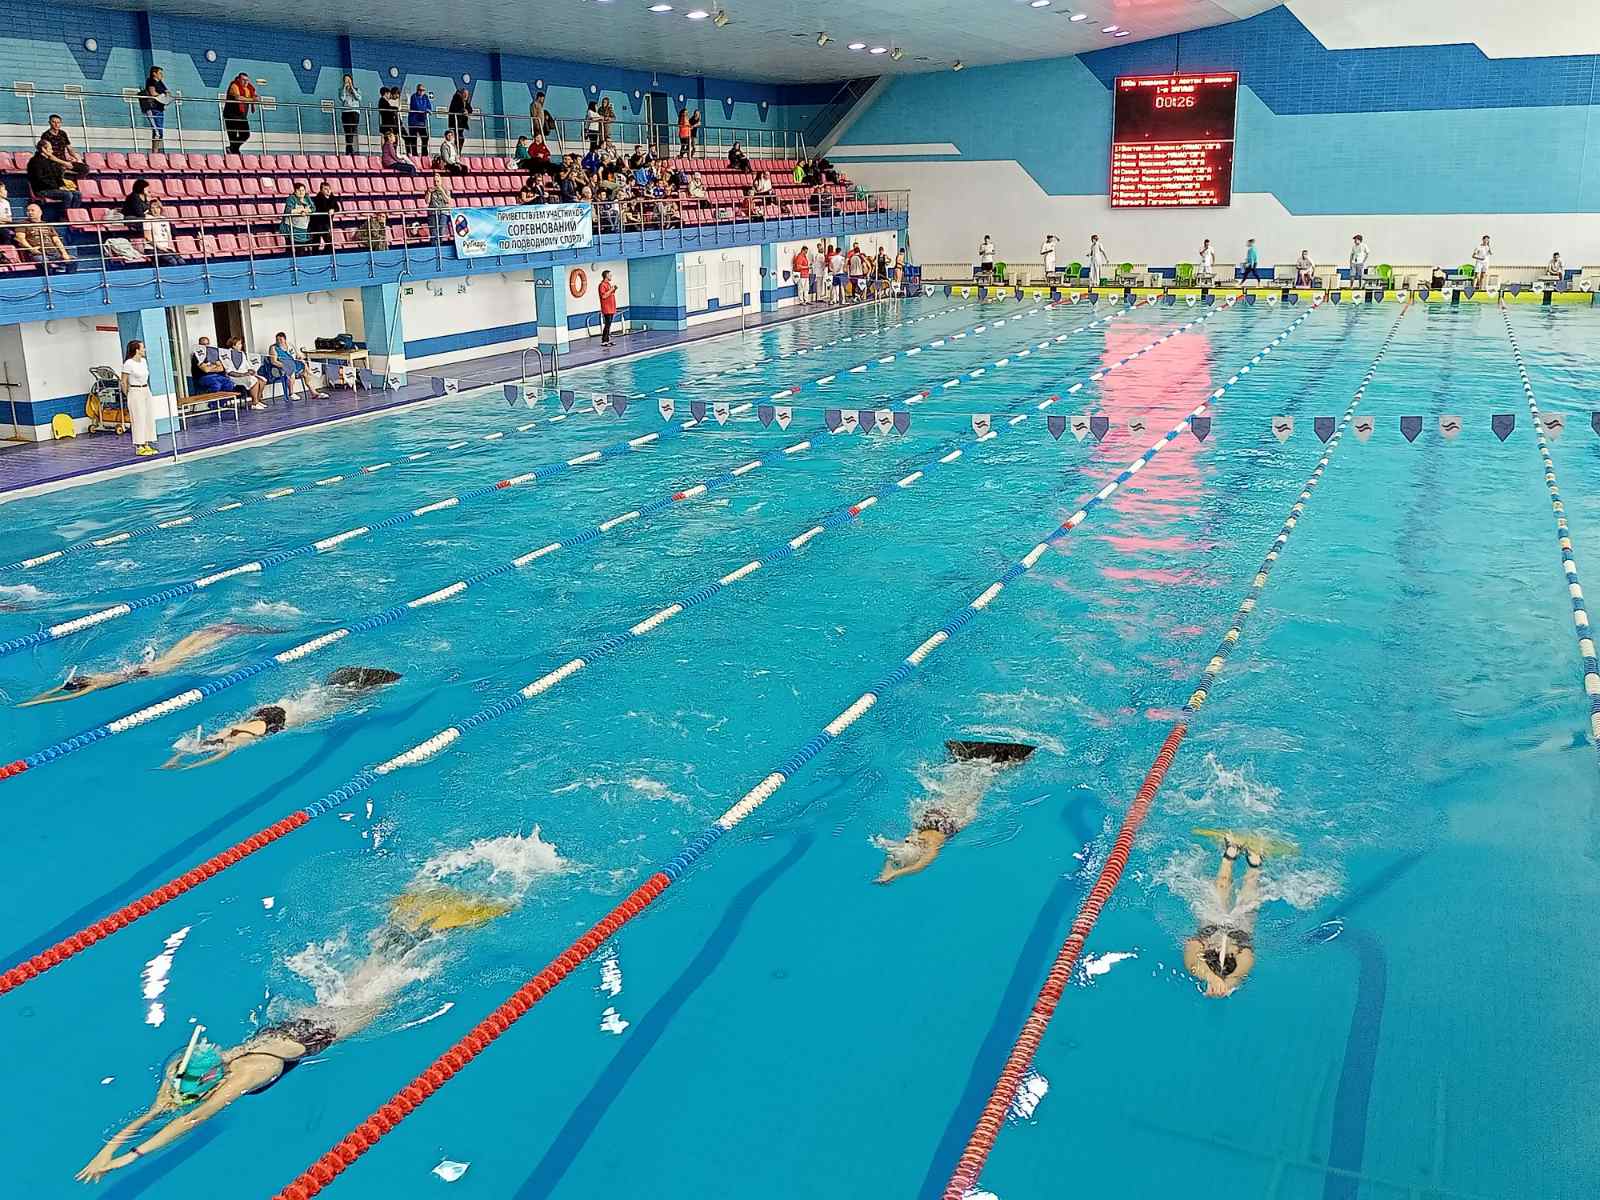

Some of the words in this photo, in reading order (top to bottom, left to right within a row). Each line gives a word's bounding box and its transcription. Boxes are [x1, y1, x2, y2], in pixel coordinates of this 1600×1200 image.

[1155, 96, 1194, 108] 00:26
[497, 211, 545, 221] ПРИВЕТСТВУЕМ
[508, 219, 577, 237] СОРЕВНОВАНИЙ
[499, 240, 510, 250] ПО
[511, 237, 559, 250] ПОДВОДНОМУ
